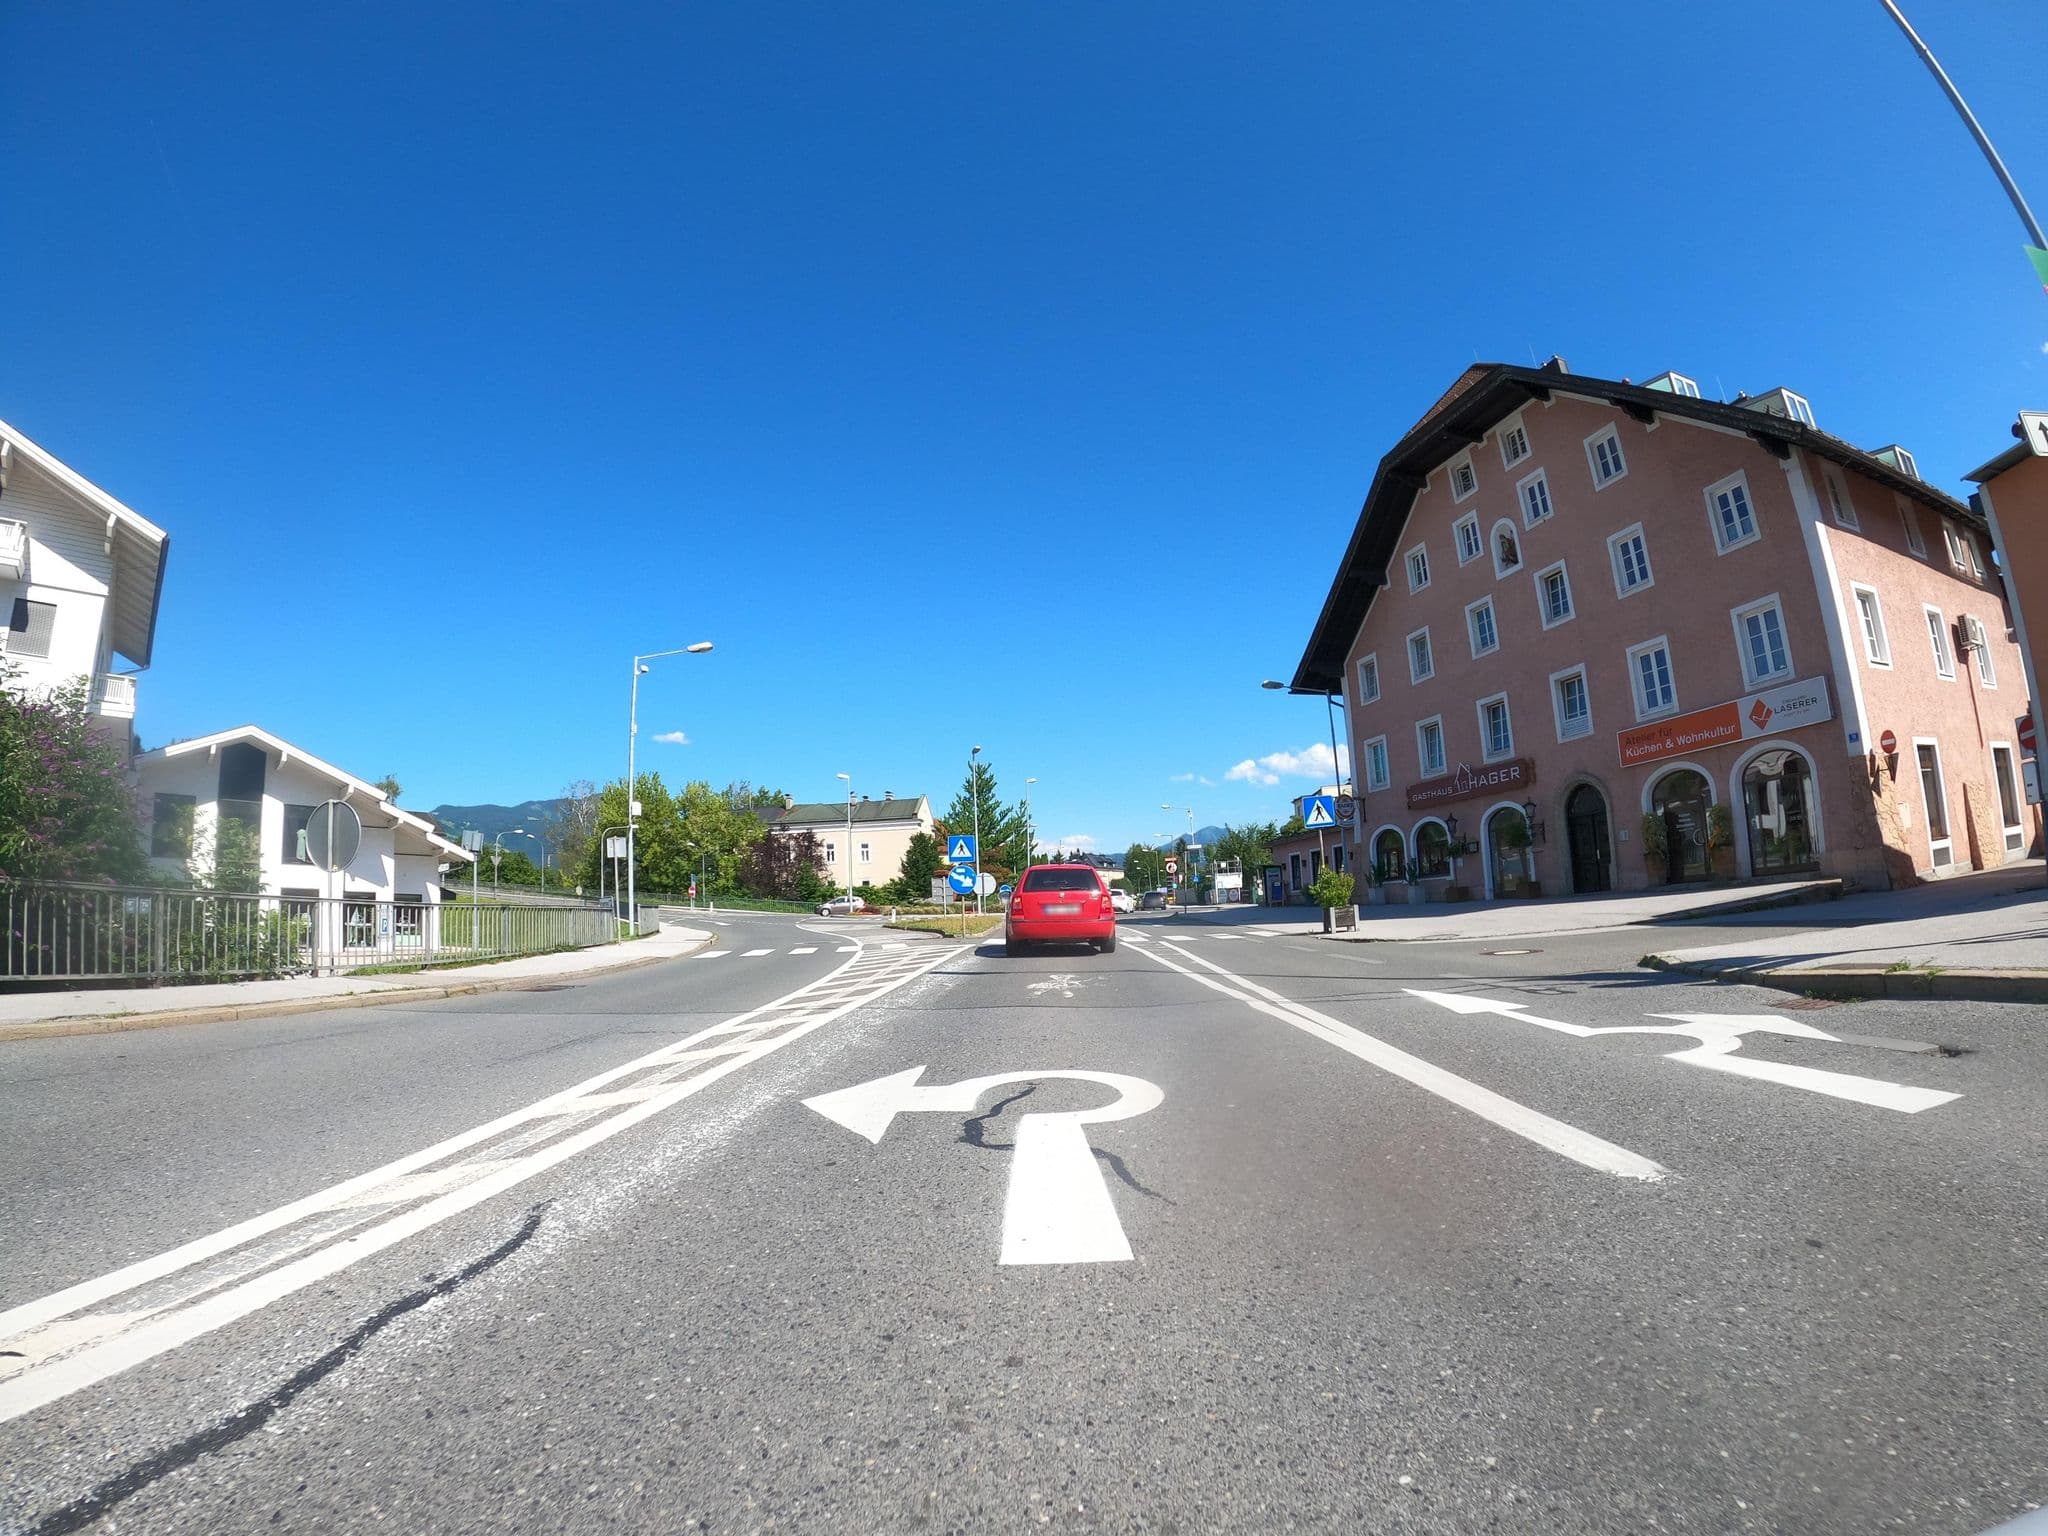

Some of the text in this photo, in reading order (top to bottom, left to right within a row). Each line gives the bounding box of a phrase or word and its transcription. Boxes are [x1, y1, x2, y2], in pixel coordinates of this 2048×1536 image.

[1774, 697, 1818, 714] LASERER
[1626, 724, 1736, 758] Küchen & Wohnkultur
[1412, 766, 1520, 802] GASTHAUS HAGER
